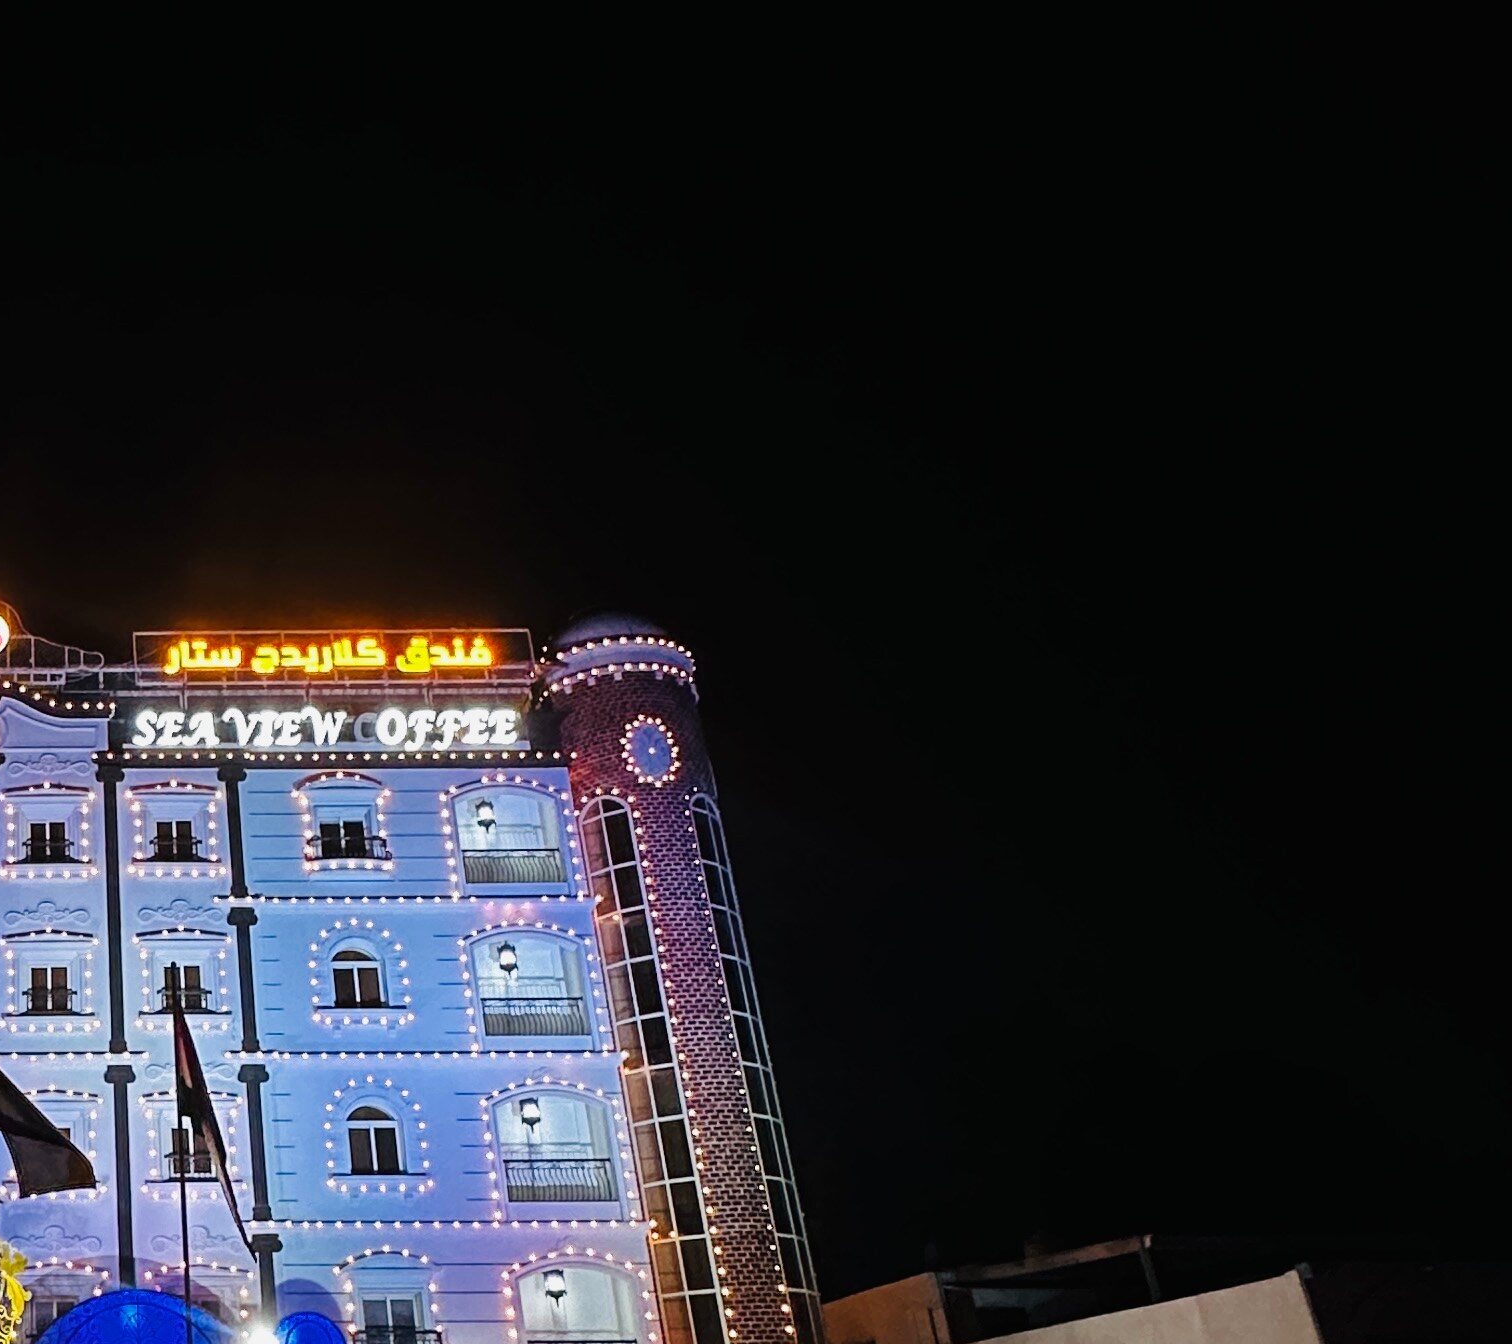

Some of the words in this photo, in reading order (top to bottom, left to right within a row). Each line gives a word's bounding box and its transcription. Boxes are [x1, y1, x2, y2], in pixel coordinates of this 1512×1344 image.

[163, 639, 242, 675] ستار
[251, 637, 387, 675] كلاريدج
[395, 635, 493, 673] فندق
[132, 709, 220, 748] SEA
[221, 706, 348, 747] VIEW
[353, 707, 519, 752] COFFEE
